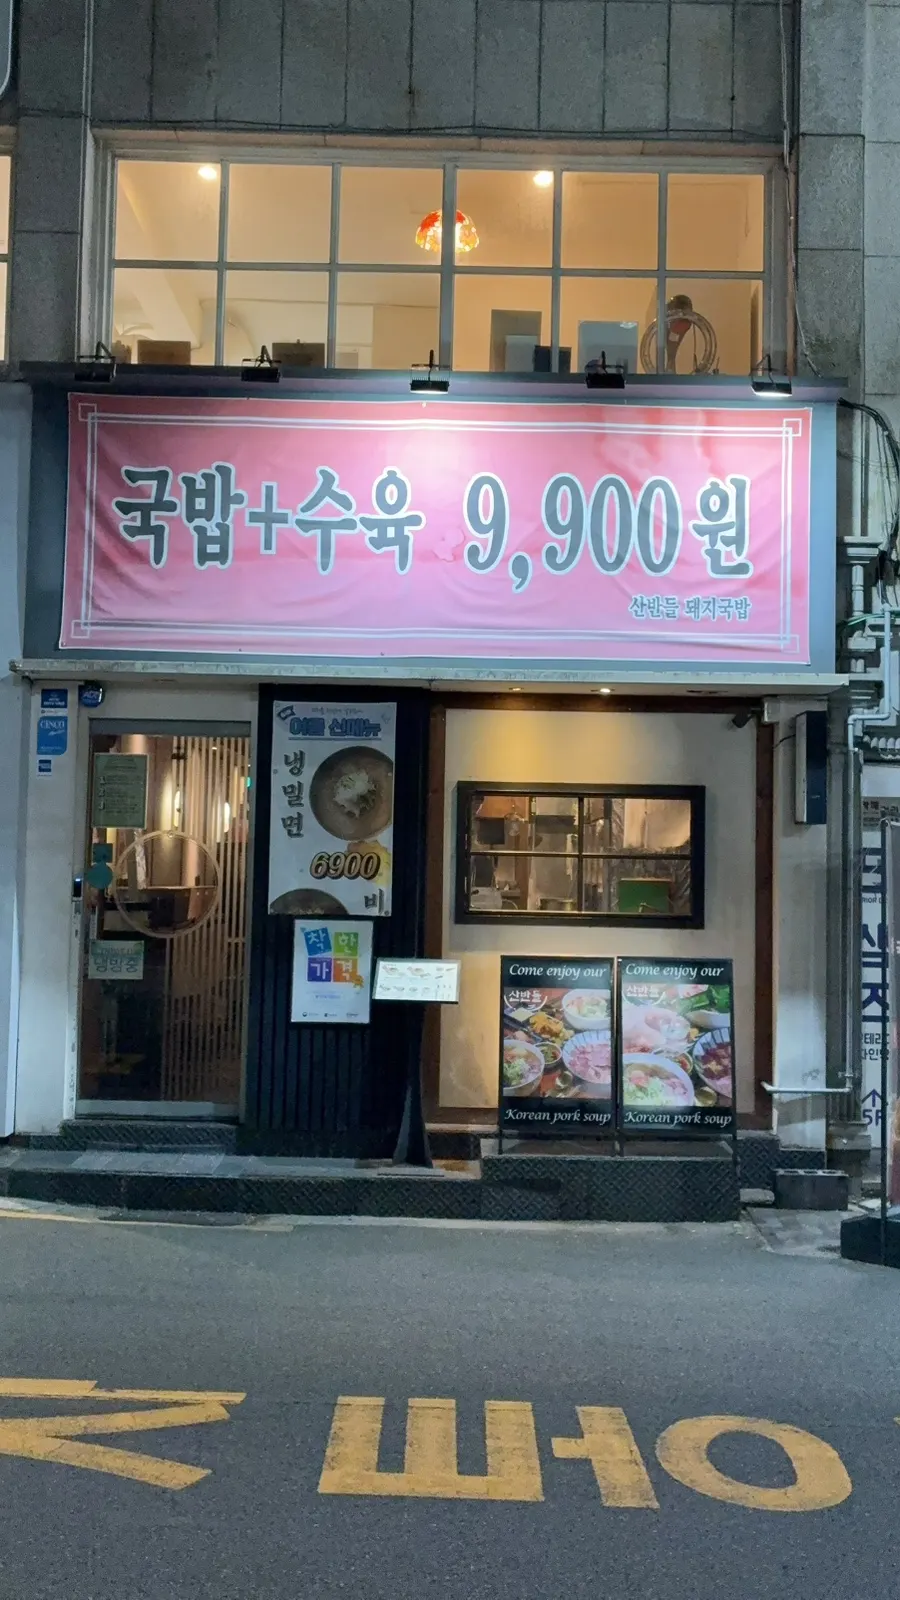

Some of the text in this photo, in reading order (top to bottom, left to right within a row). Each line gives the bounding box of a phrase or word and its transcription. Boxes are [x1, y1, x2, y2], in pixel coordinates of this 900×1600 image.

[112, 462, 753, 593] 국밥+수육 9,900원
[628, 595, 752, 621] 산반들 돼지국밥
[328, 718, 381, 737] 신메뉴
[309, 850, 381, 880] 6900
[307, 928, 357, 953] 착한
[310, 959, 353, 981] 가격
[509, 963, 607, 980] Come enjoy our
[625, 963, 724, 980] Come enjoy our
[508, 989, 542, 1003] 산반들
[504, 1109, 611, 1124] Korean pork soup
[624, 1111, 732, 1127] Korean pork soup
